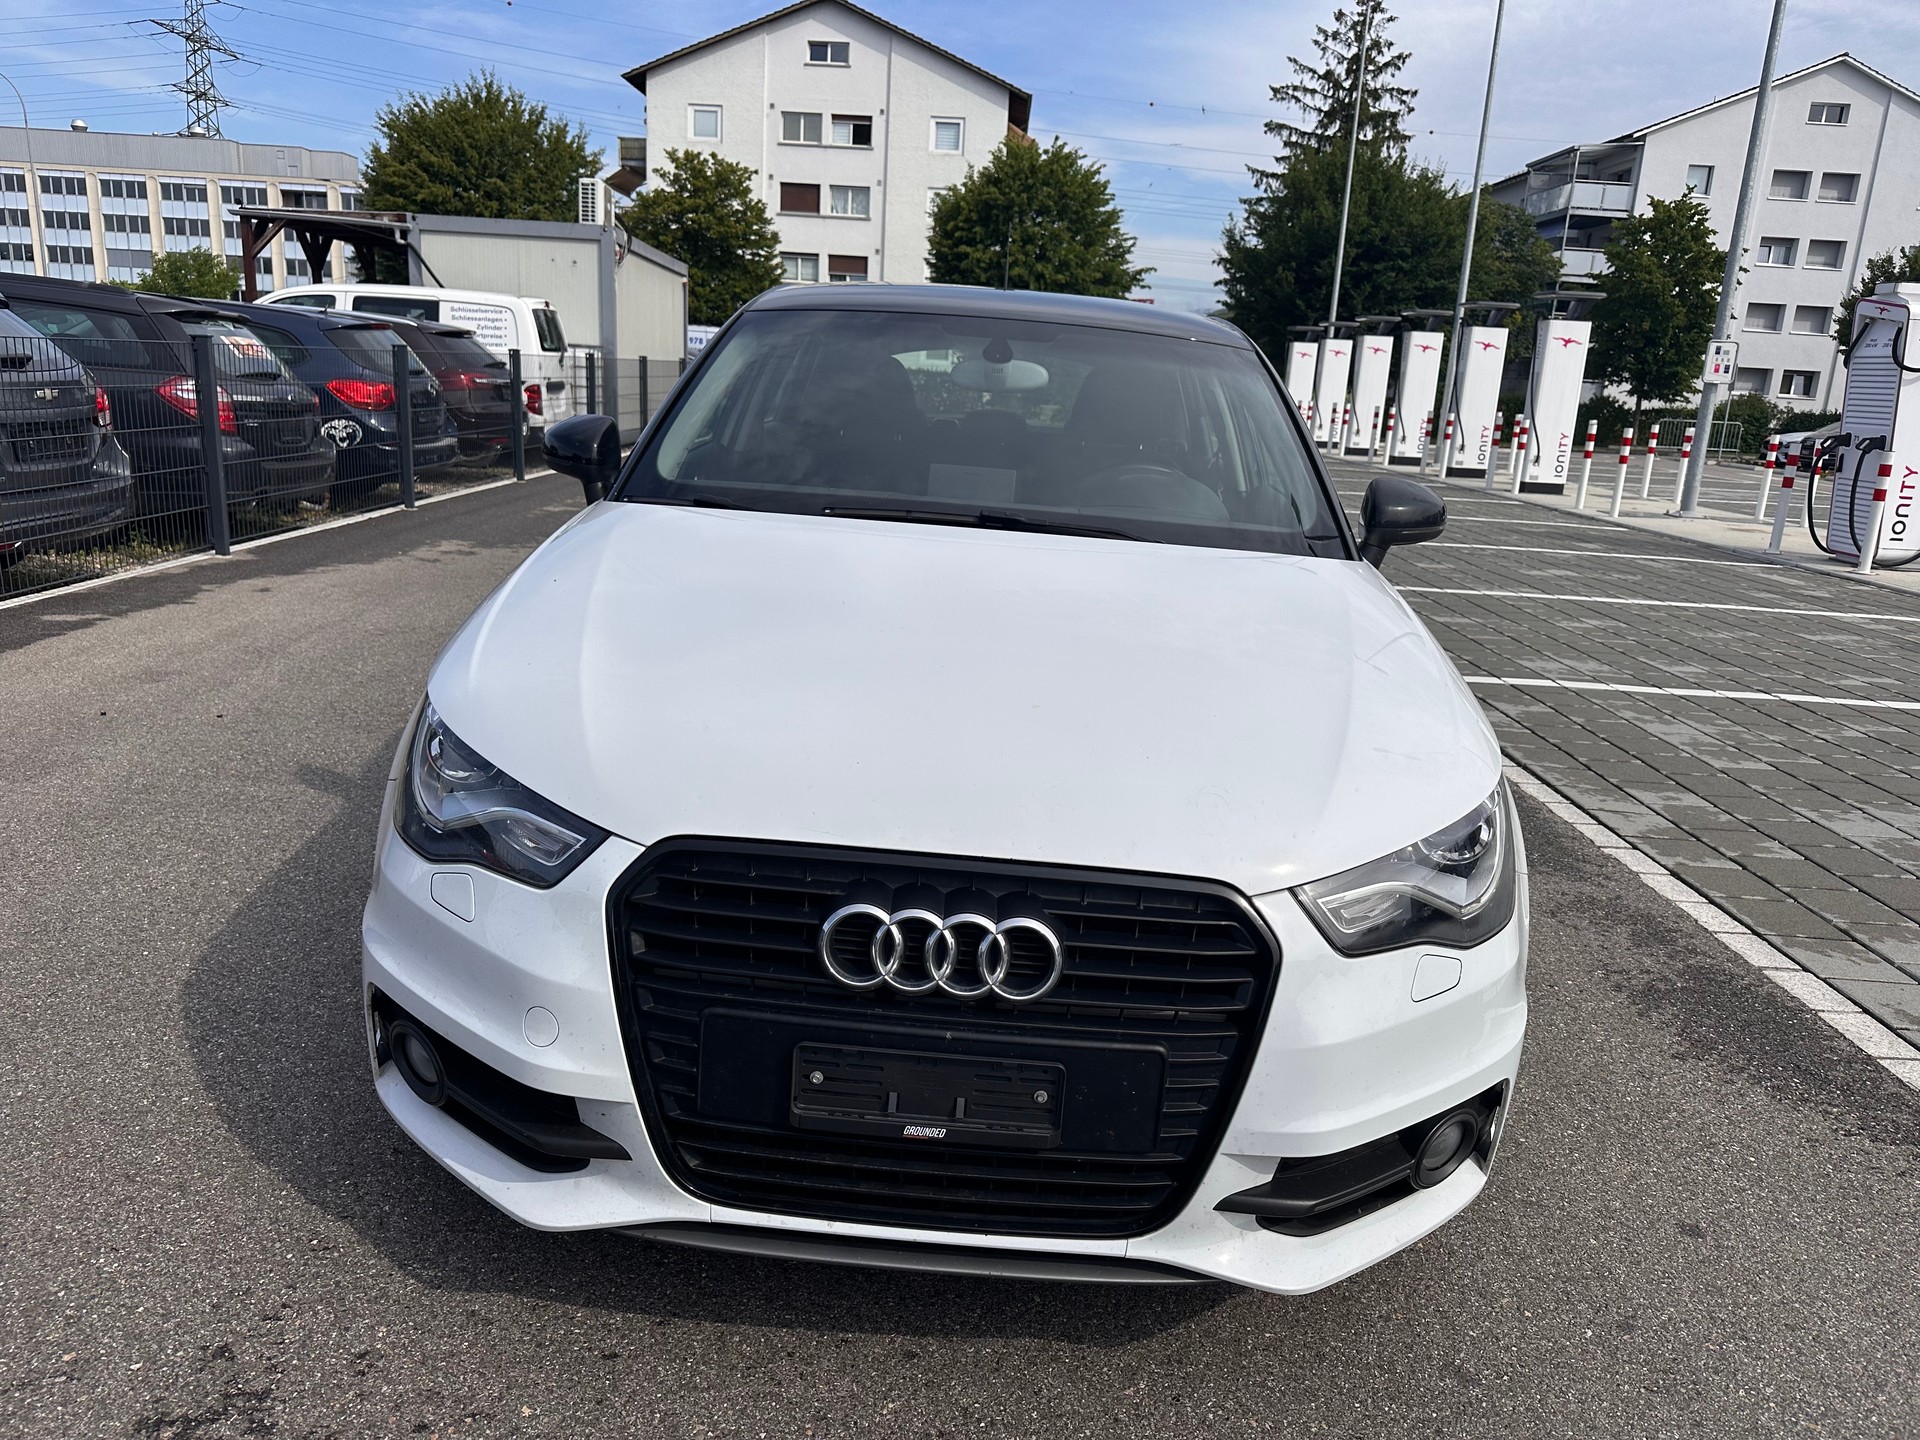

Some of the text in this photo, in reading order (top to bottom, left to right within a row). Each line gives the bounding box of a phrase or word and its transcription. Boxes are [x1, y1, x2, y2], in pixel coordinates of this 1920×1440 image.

[450, 306, 503, 314] Schlüsselservice
[451, 314, 503, 323] Schliessanlagen
[476, 323, 503, 331] Zylinder
[1477, 425, 1490, 465] IONITY
[1554, 432, 1569, 477] IONITY
[1889, 465, 1919, 542] IONITY
[903, 1125, 947, 1138] GROUNDED
